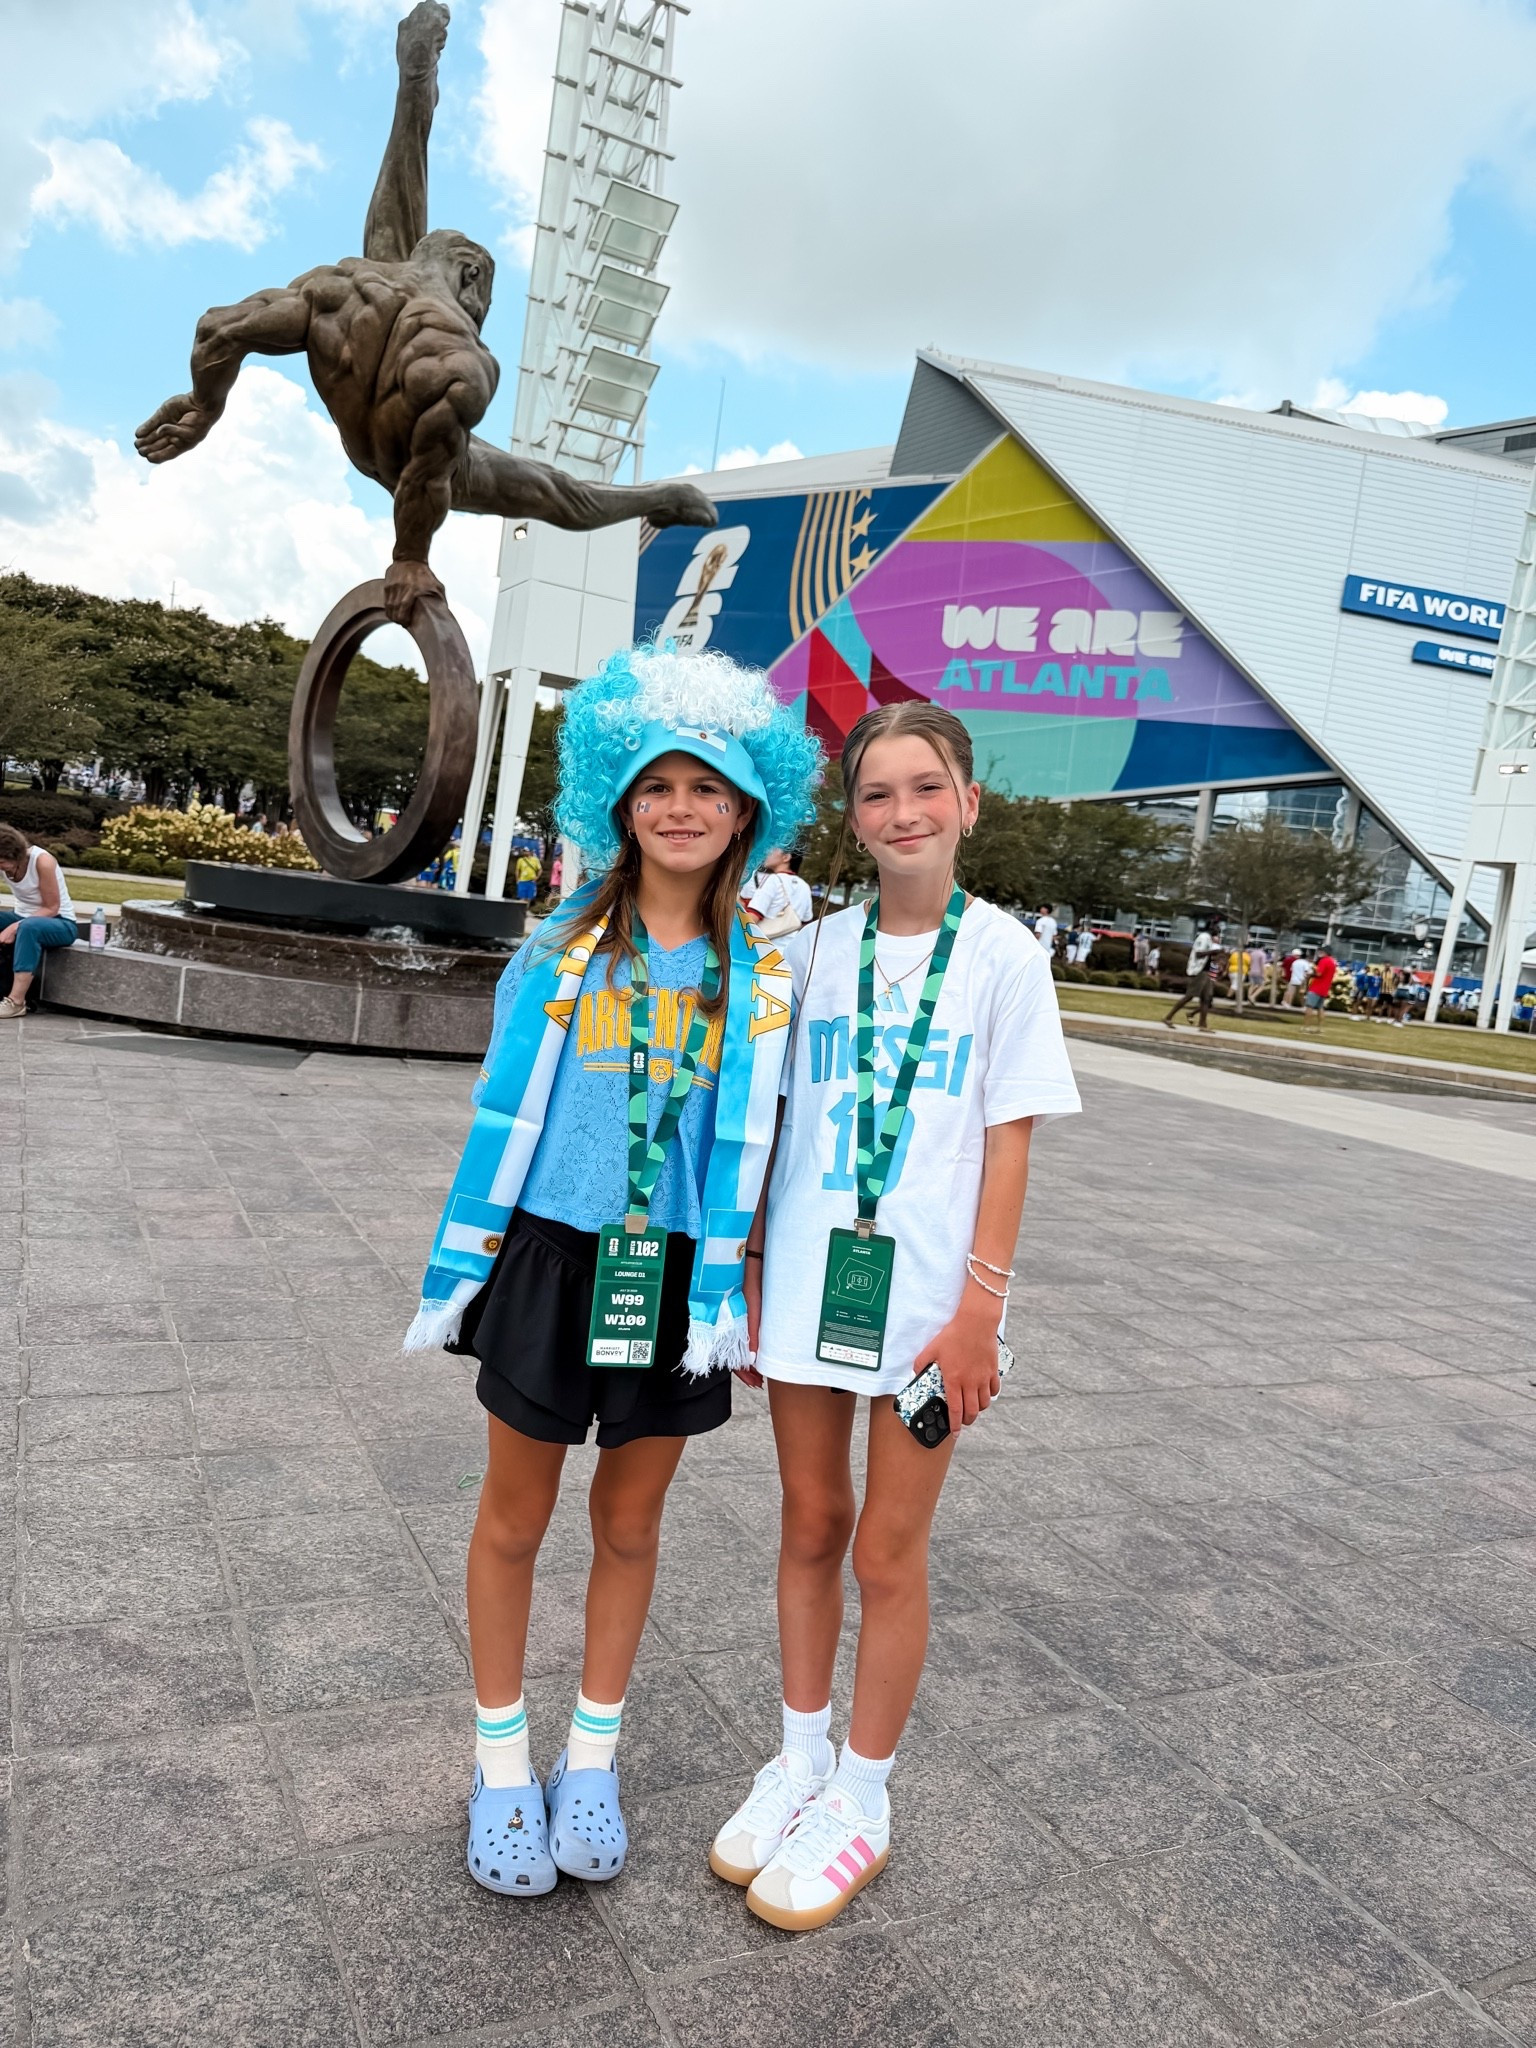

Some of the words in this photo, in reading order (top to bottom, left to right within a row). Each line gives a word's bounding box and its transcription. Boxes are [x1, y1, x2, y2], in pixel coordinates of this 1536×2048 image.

[1359, 582, 1419, 613] FIFA
[1423, 594, 1504, 629] WORL
[942, 605, 1040, 652] WE
[673, 634, 694, 648] IFA
[1468, 654, 1497, 670] AR
[938, 658, 1174, 701] ATLANTA
[636, 1241, 659, 1256] 102
[614, 1270, 638, 1278] LOUNGE
[611, 1294, 644, 1305] W99
[605, 1314, 646, 1326] W100
